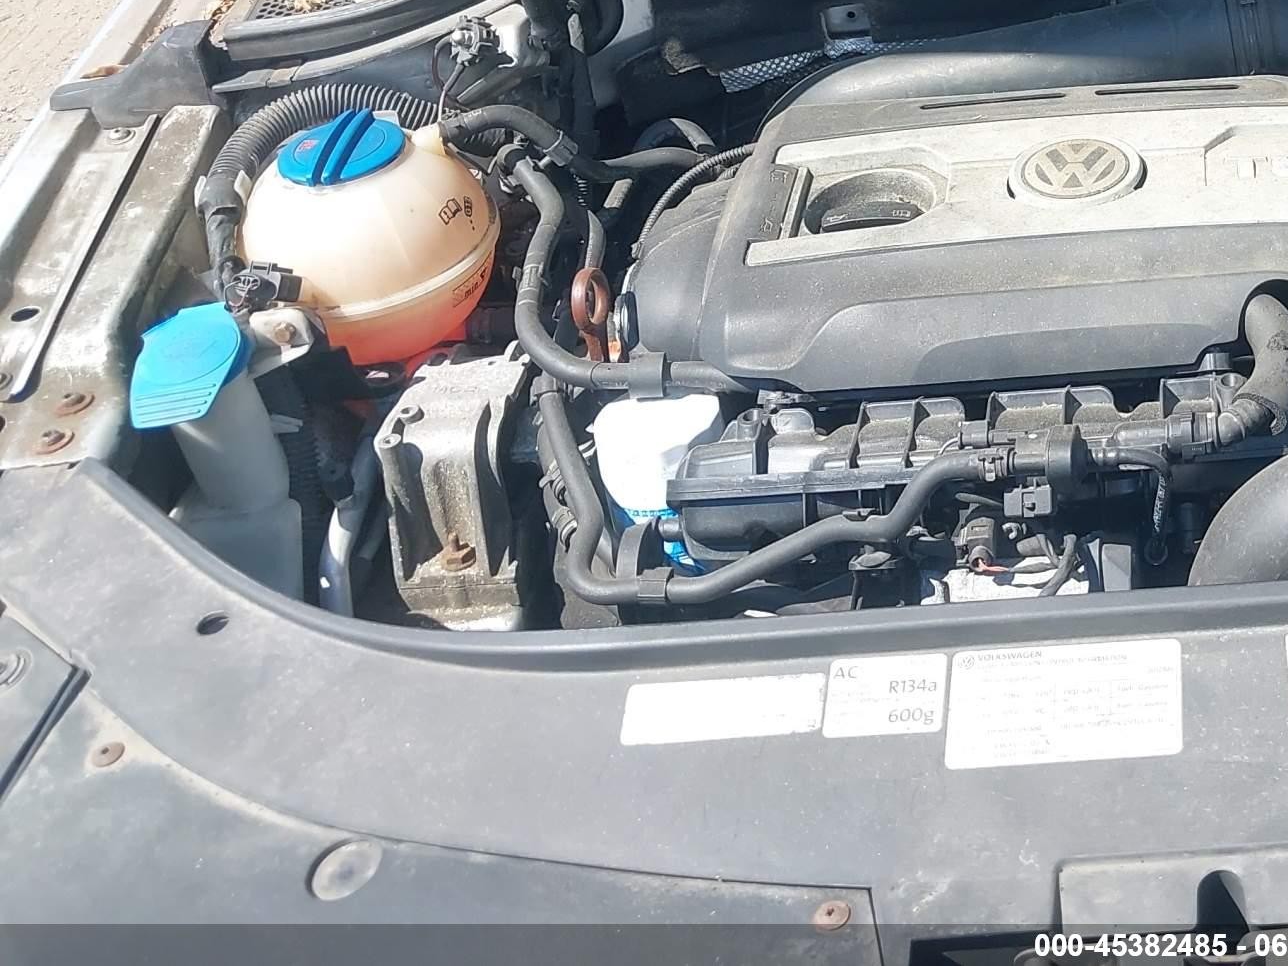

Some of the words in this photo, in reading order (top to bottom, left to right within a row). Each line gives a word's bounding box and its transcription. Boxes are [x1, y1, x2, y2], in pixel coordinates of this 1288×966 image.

[977, 650, 1042, 661] VOLKSWAGEN
[889, 679, 937, 694] R134a
[888, 707, 935, 725] 600g
